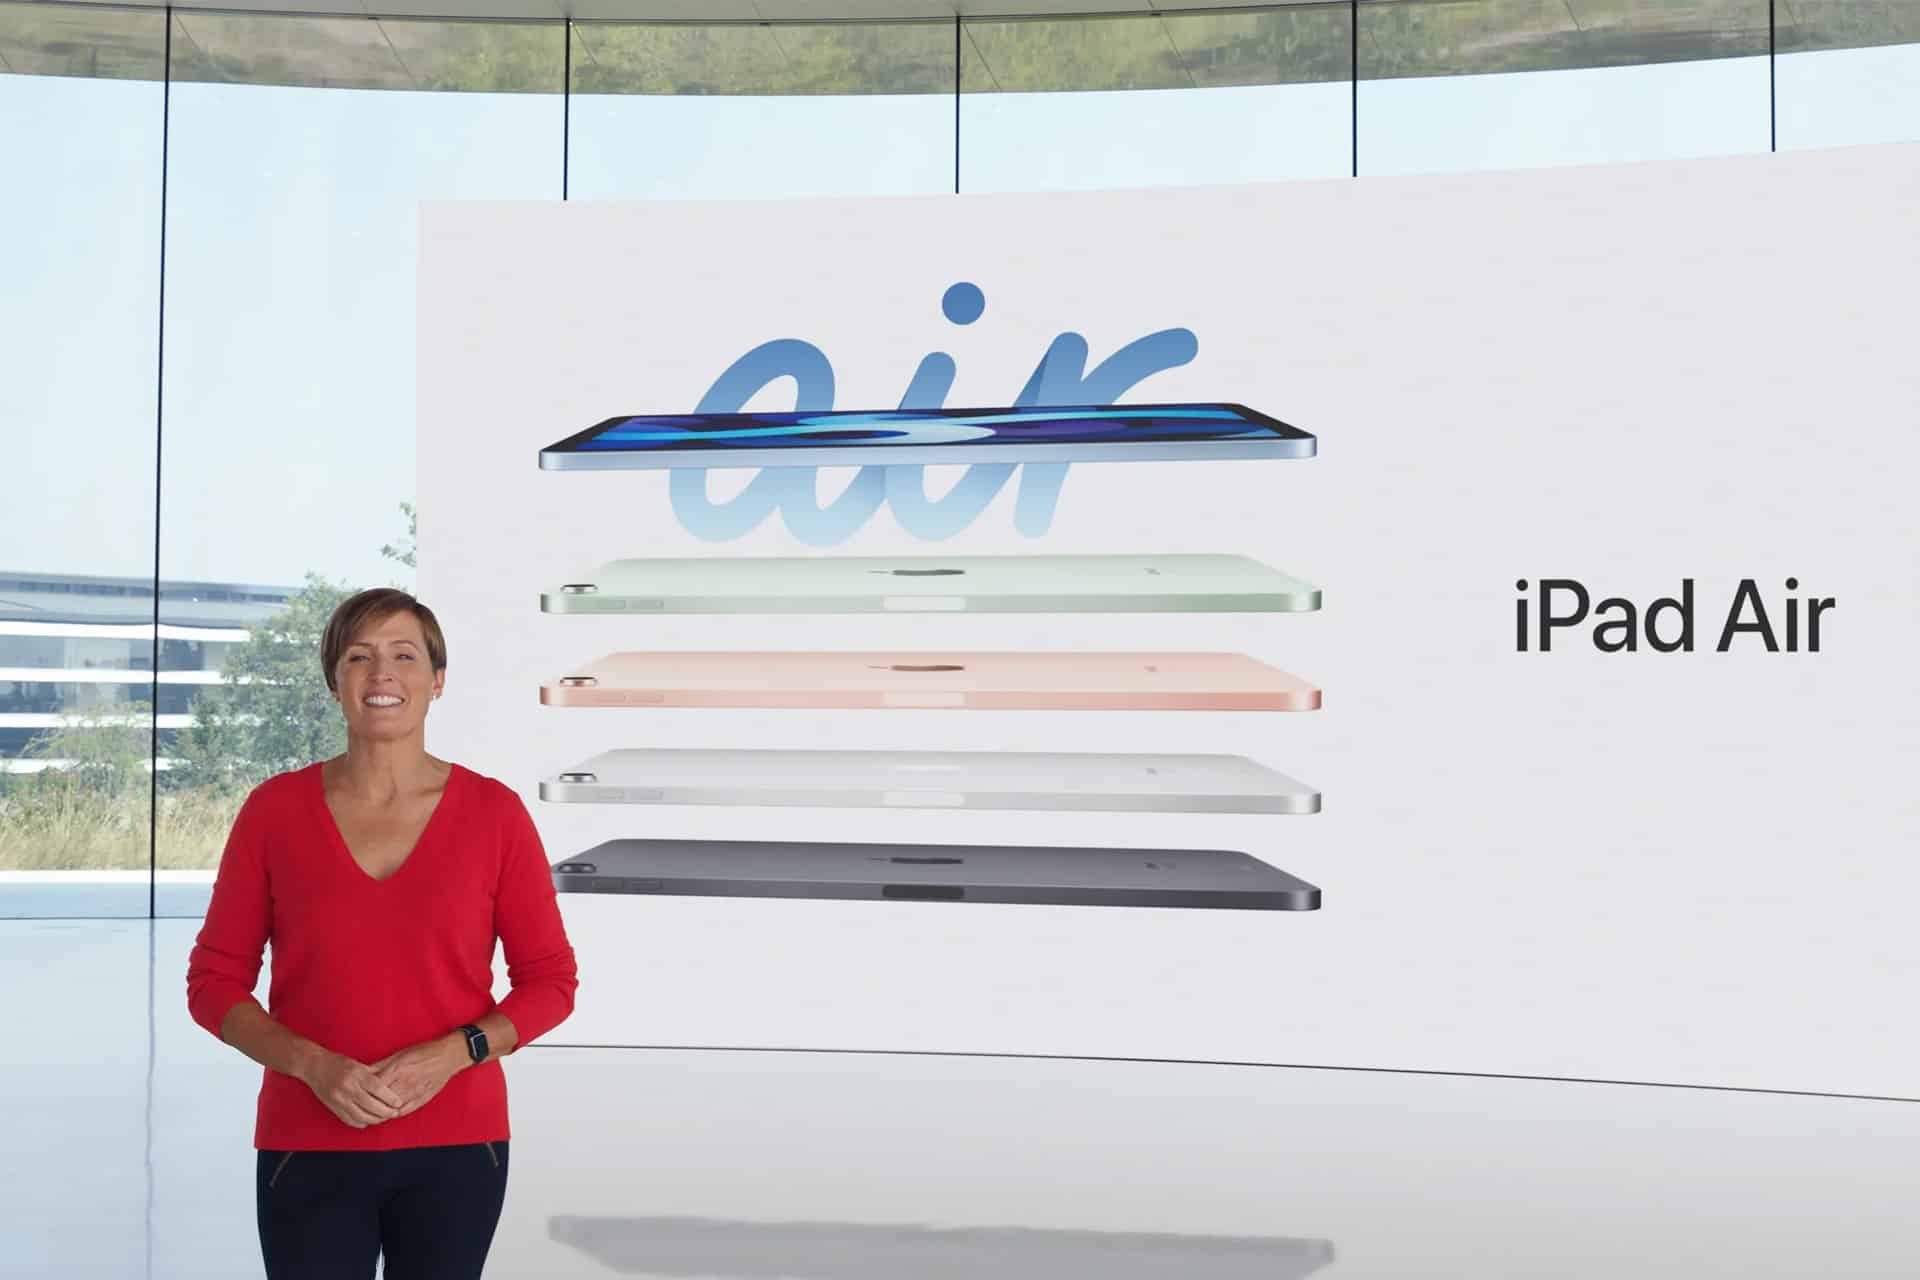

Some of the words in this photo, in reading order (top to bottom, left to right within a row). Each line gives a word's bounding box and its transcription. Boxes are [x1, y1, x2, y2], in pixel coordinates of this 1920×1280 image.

[669, 281, 1199, 547] air
[1516, 578, 1694, 653] iPad
[1716, 577, 1836, 653] Air
